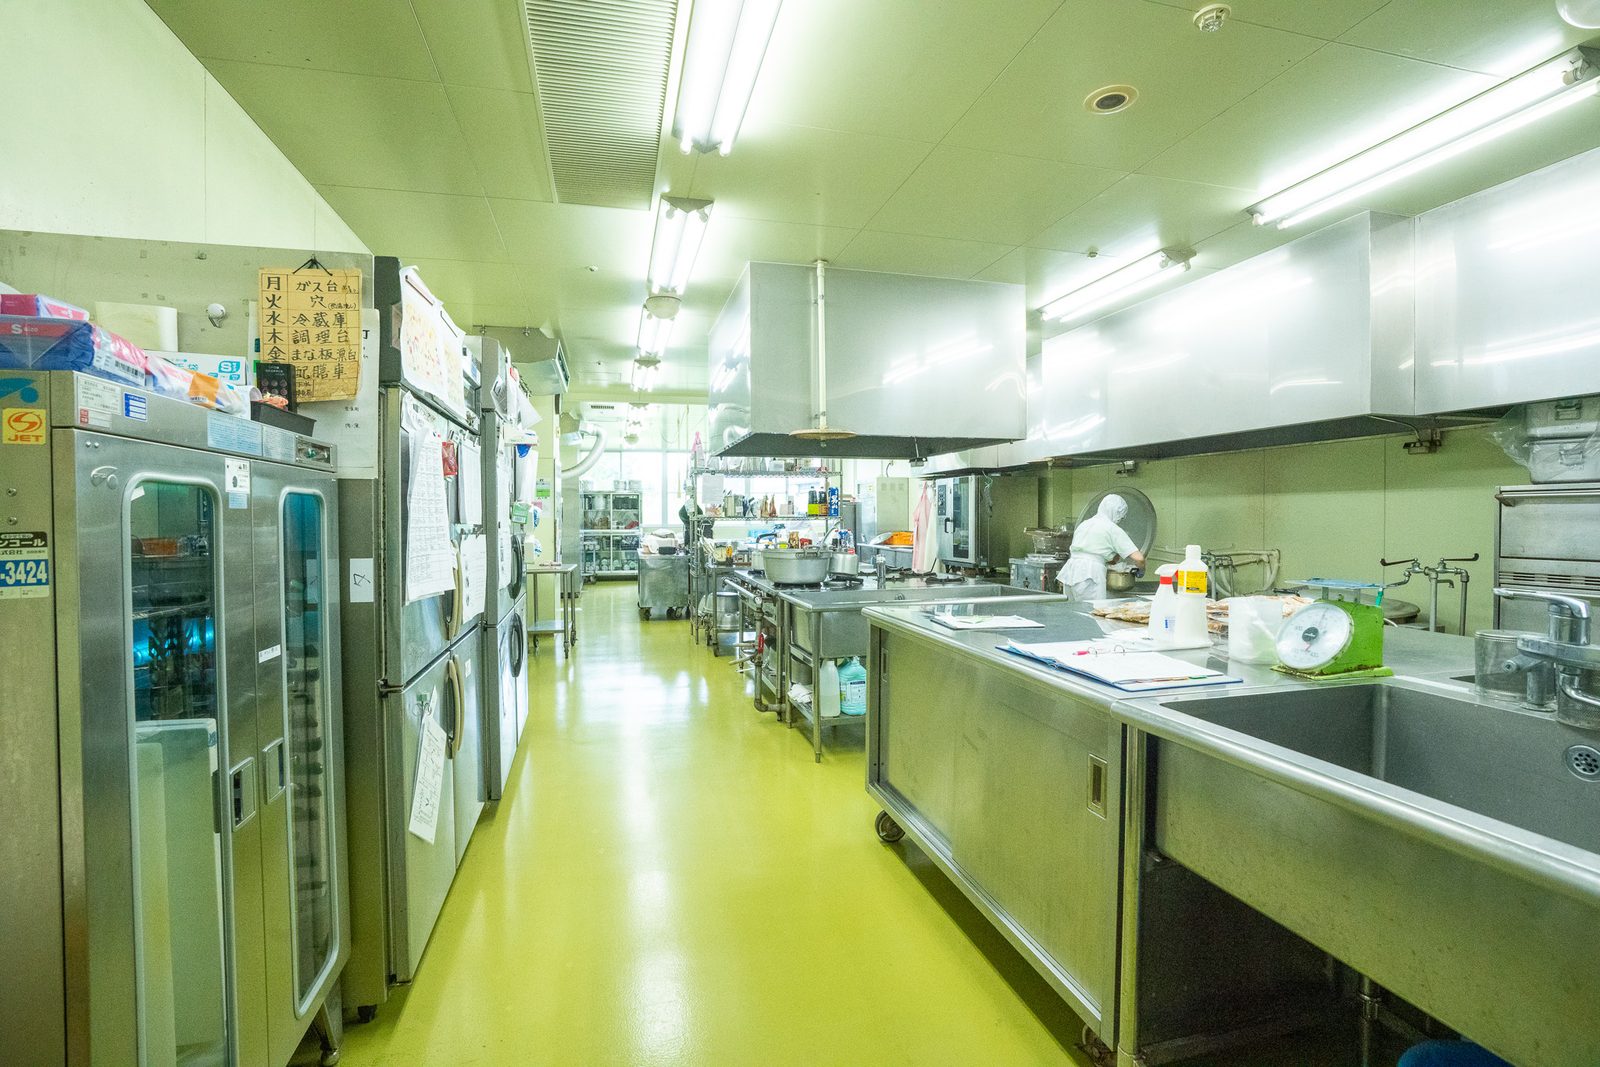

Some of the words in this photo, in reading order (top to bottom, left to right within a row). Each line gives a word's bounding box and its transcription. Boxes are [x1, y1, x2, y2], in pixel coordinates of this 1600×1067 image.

[266, 276, 281, 291] 月
[295, 279, 338, 293] ガス台
[265, 293, 282, 309] 火
[310, 294, 327, 309] 穴
[265, 310, 285, 326] 水
[291, 311, 347, 328] 冷蔵庫
[266, 328, 284, 344] 木
[292, 329, 349, 344] 調理台
[267, 345, 286, 363] 金
[8, 434, 43, 442] JET
